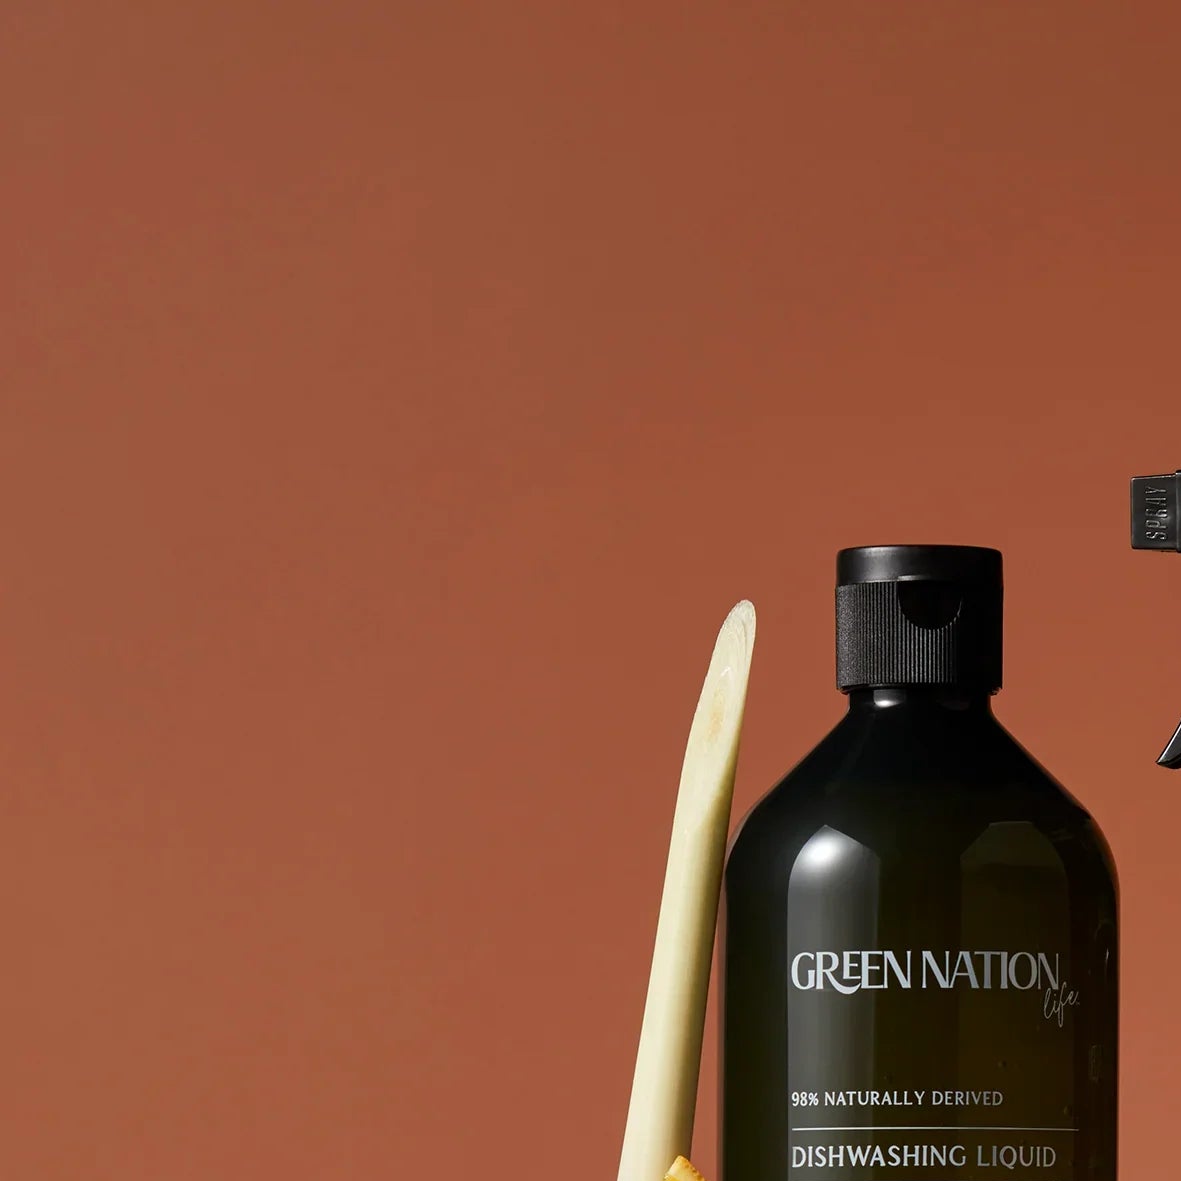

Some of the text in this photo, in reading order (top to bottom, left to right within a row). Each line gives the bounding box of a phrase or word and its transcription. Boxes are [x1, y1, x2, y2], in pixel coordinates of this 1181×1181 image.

[1145, 486, 1168, 540] SPRAY
[791, 951, 1058, 994] GREEN NATION
[792, 1091, 1002, 1106] 98% NATURALLY DERIVED
[792, 1146, 1056, 1170] DISHWASHING LIQUID
